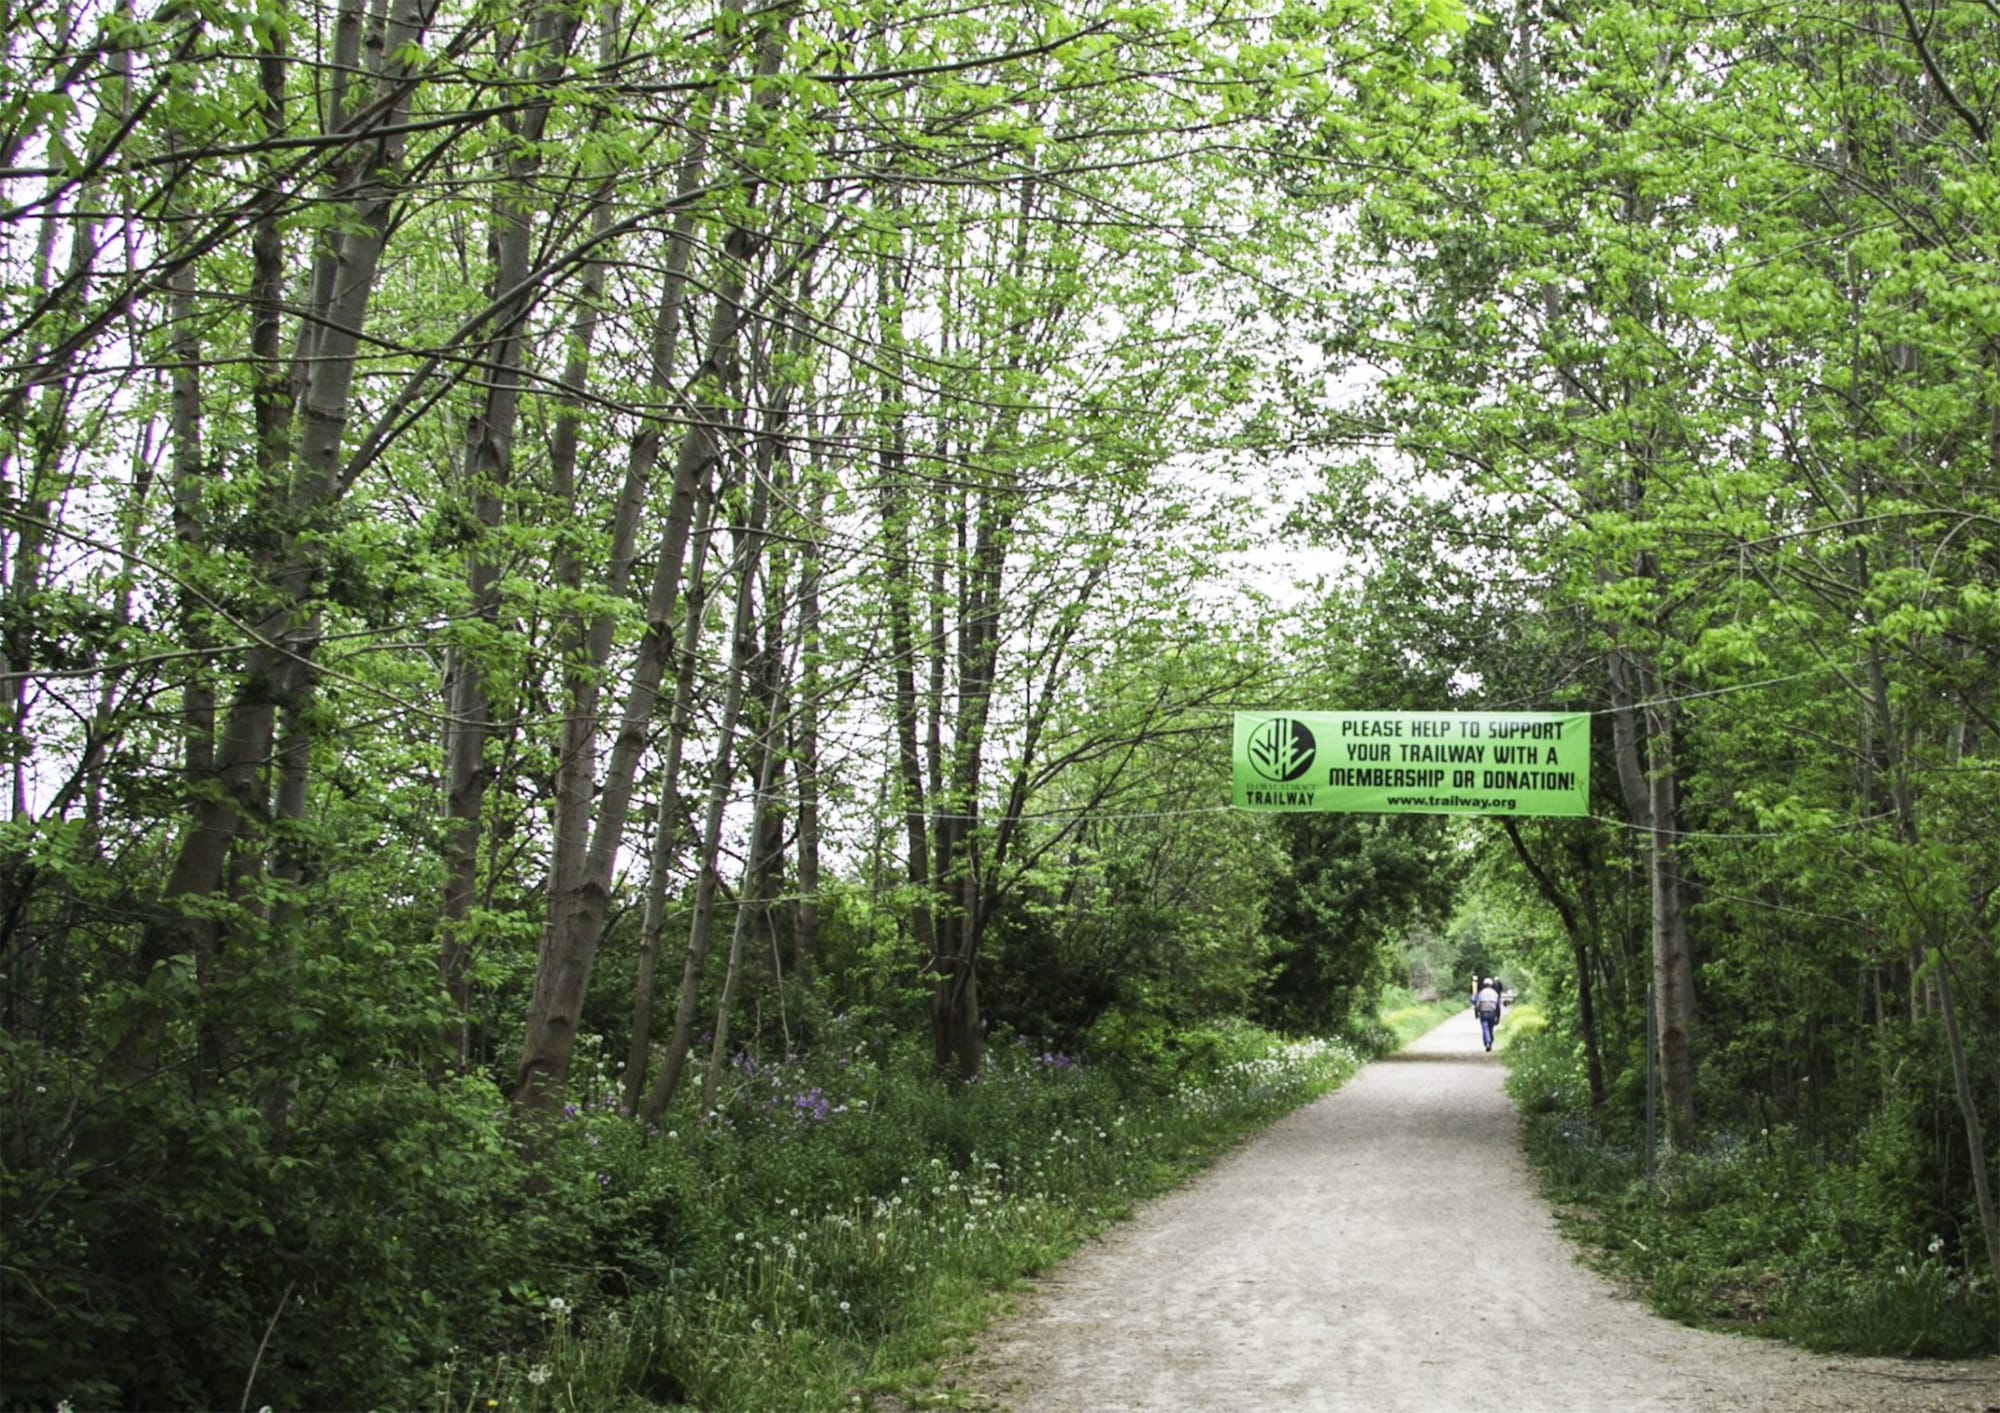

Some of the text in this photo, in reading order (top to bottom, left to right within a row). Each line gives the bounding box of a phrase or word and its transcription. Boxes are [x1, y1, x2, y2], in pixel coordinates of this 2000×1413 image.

[1342, 720, 1564, 740] PLEASE HELP TO SUPPORT
[1347, 743, 1558, 765] YOUR TRAILWAY WITH A
[1329, 768, 1575, 791] MEMBERSHIP OR DONATION!
[1246, 791, 1315, 806] TRAILWAY
[1387, 795, 1516, 810] www.trailway.org
